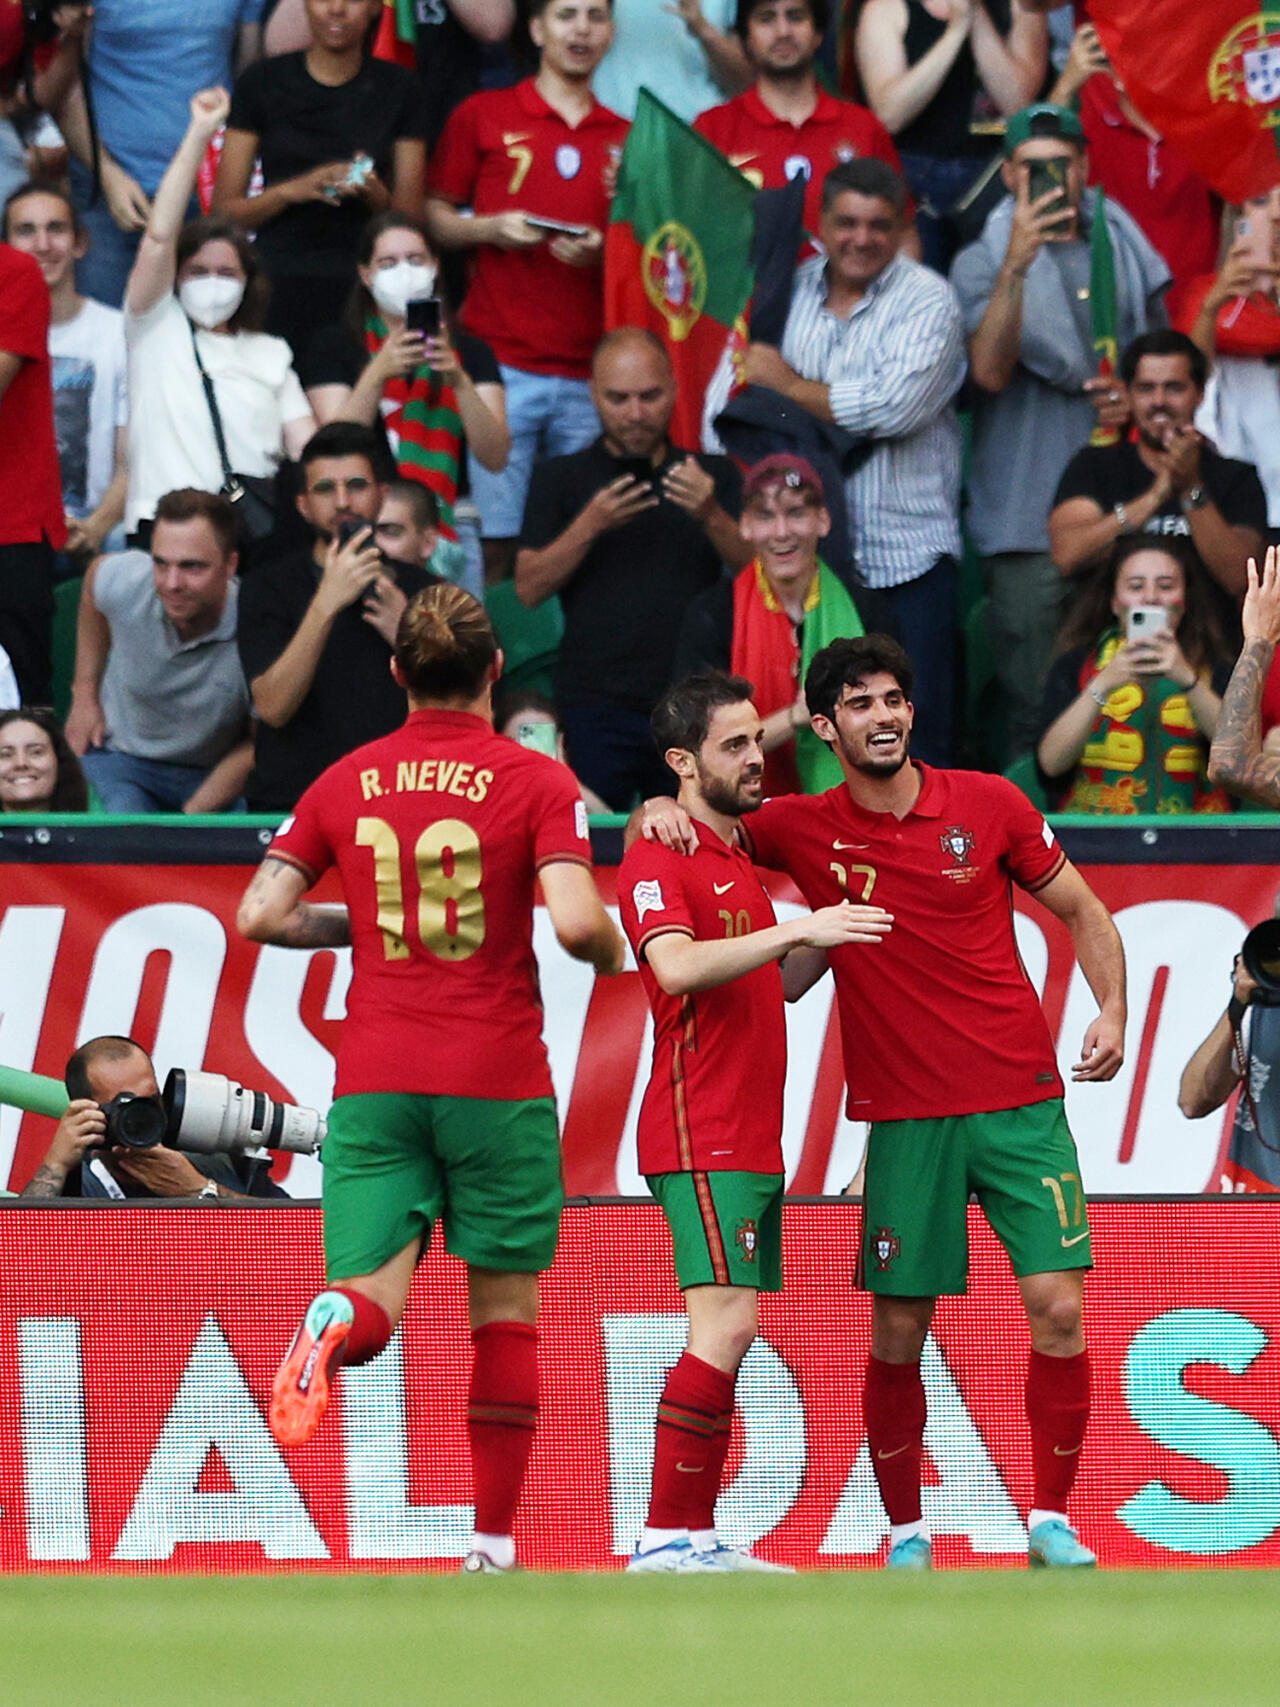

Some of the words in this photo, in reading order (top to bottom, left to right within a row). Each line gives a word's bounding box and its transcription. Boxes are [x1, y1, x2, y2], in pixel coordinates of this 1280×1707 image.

[507, 146, 533, 194] 7
[360, 768, 391, 801] R.
[396, 761, 494, 803] NEVES
[356, 817, 486, 962] 18
[830, 862, 877, 902] 17
[1041, 1172, 1082, 1229] 17
[602, 1312, 1030, 1556] DA
